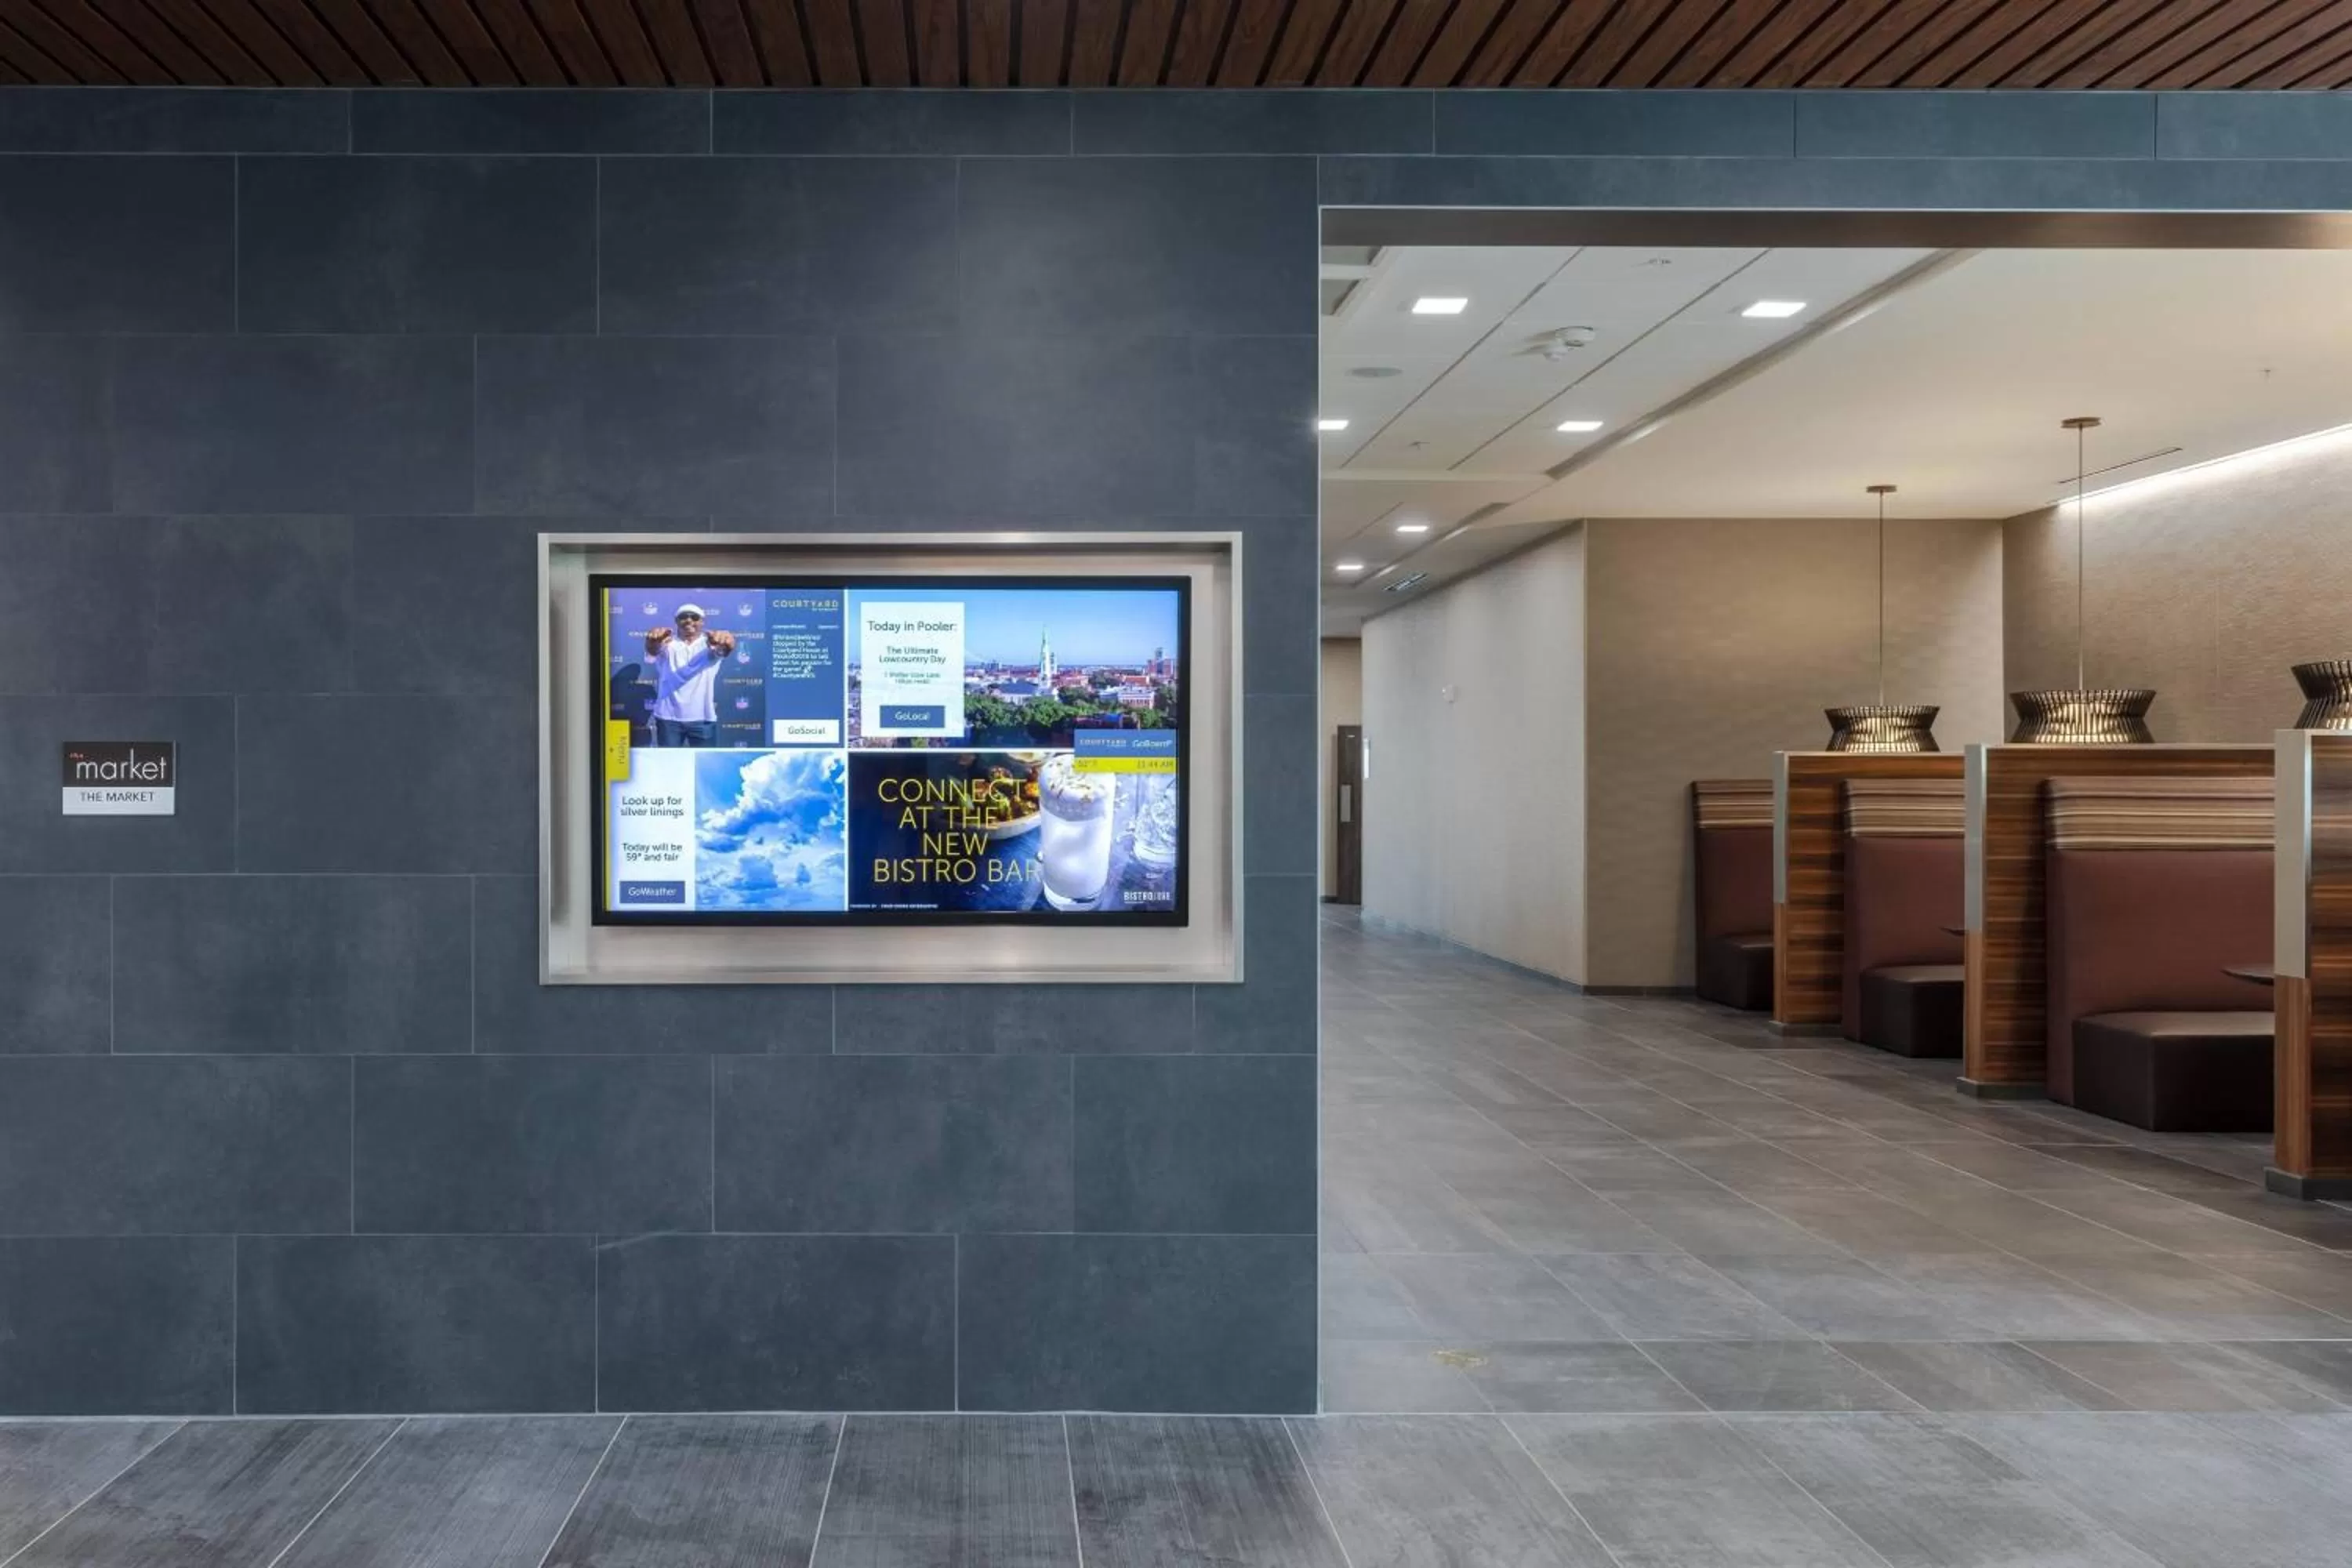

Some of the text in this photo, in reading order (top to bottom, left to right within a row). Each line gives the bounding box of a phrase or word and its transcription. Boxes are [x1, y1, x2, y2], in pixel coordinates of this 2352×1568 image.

[772, 599, 839, 608] COURTYARD
[867, 620, 957, 633] Today in Pooler:
[887, 646, 939, 655] The Ultimate
[879, 655, 946, 664] Lowcountry Day
[895, 711, 930, 721] GoLocal
[787, 725, 826, 735] GoSocial
[76, 748, 167, 780] market
[877, 779, 1027, 803] CONNECT
[80, 791, 154, 802] THE MARKET
[622, 796, 683, 807] Look up for
[620, 808, 684, 818] silver linings
[898, 806, 1000, 829] AT THE
[622, 843, 683, 852] Today will be
[923, 832, 988, 856] NEW
[644, 853, 662, 862] and
[664, 853, 679, 862] fair
[873, 858, 1041, 883] BISTRO BAR
[628, 887, 677, 896] GoWeather
